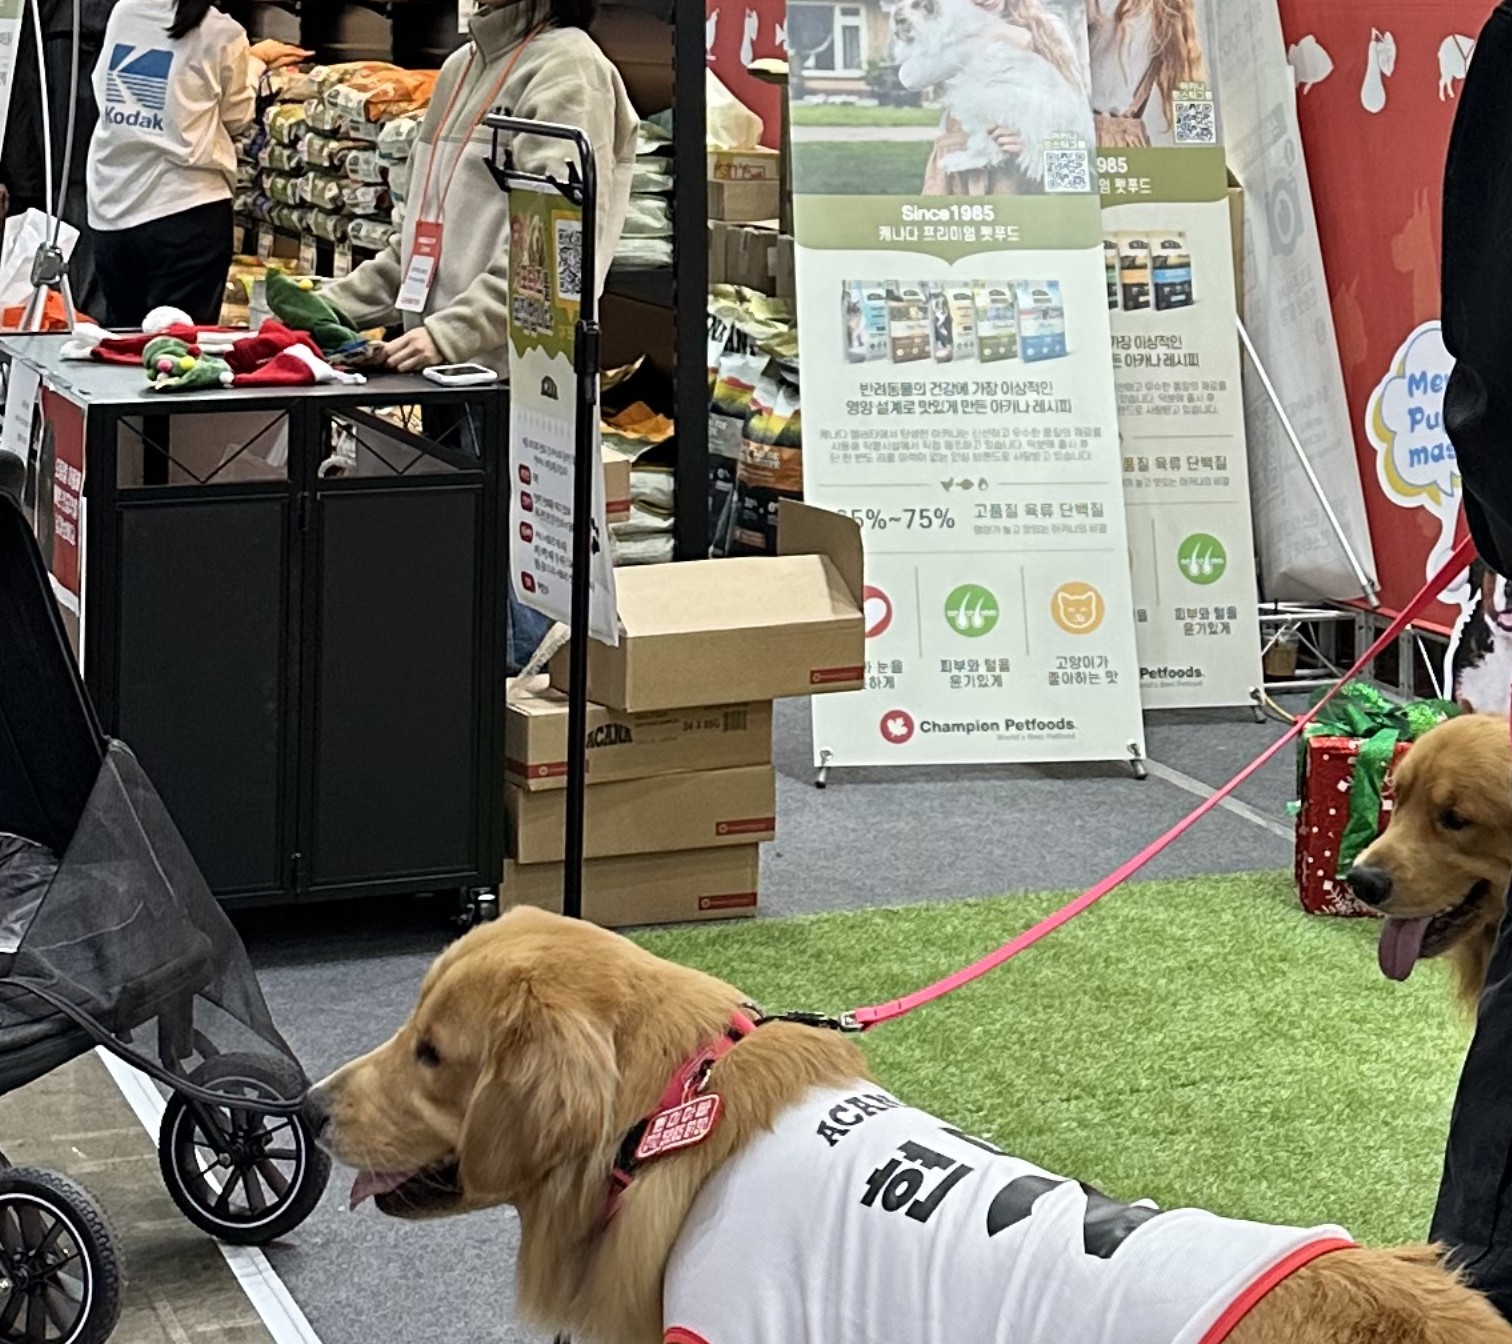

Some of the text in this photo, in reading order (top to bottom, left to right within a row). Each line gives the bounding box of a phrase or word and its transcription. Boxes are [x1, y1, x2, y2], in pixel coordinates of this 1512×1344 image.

[105, 105, 164, 131] Kodak
[879, 225, 1020, 241] 캐나다 프리미엄 펫푸드
[1134, 335, 1182, 350] 이상적인
[1163, 352, 1200, 367] 레시피
[860, 380, 1053, 397] 반려동물의 건강에 가장 이상적인
[846, 400, 873, 415] 영양
[876, 400, 916, 414] 설계로
[918, 399, 958, 414] 맛있게
[960, 399, 988, 413] 만든
[1032, 399, 1072, 413] 레시피
[1408, 406, 1444, 433] Pu
[836, 508, 955, 530] 5%~75%
[974, 503, 1019, 519] 고품질
[1060, 502, 1104, 518] 단백질
[1055, 655, 1109, 670] 고양이가
[864, 676, 894, 689] 하게
[1105, 671, 1119, 685] 맛
[920, 718, 1075, 734] Champion Petfoods
[586, 723, 633, 749] ACANA
[861, 1134, 985, 1223] 현
